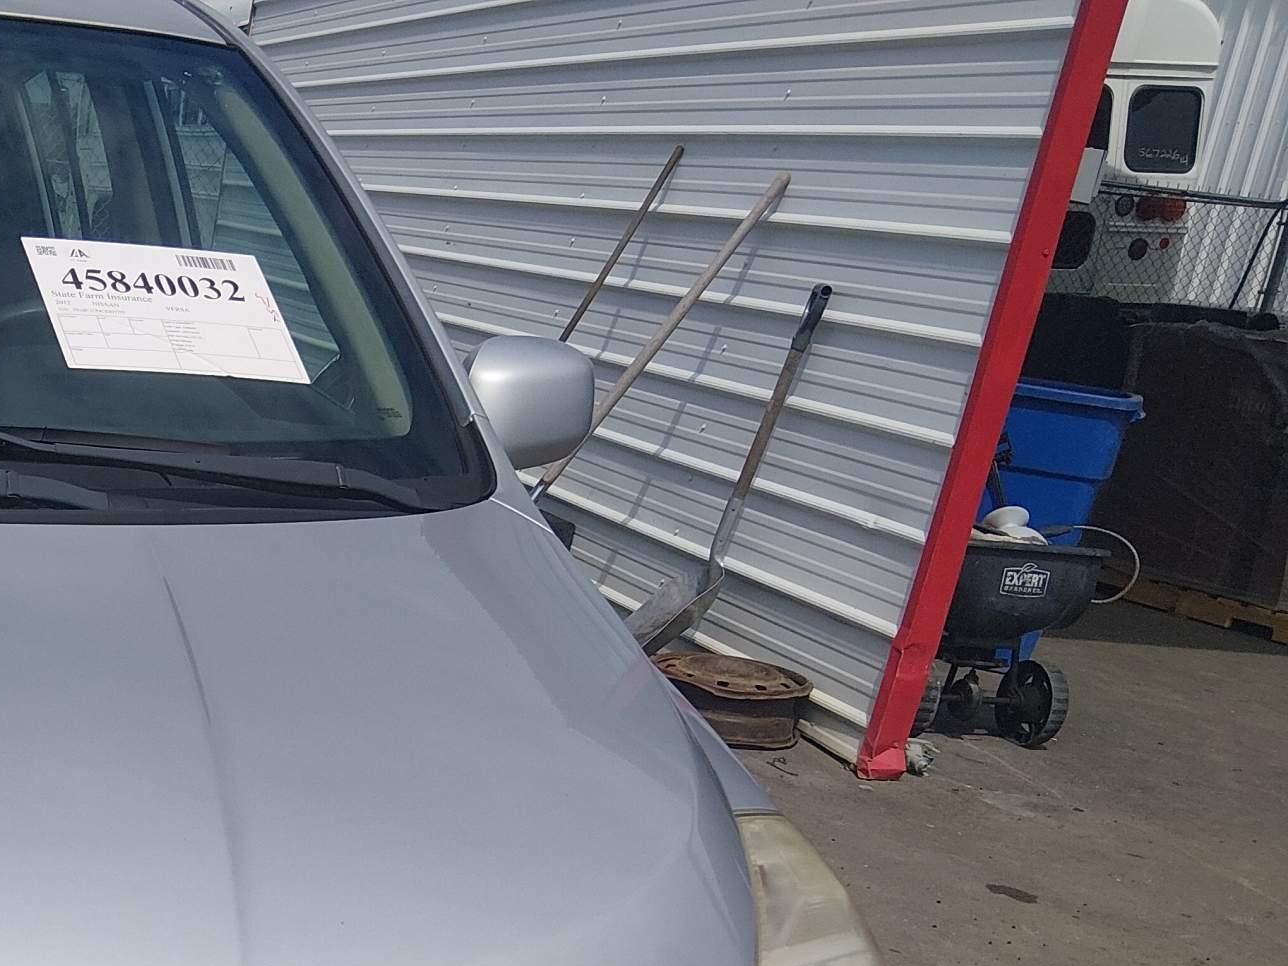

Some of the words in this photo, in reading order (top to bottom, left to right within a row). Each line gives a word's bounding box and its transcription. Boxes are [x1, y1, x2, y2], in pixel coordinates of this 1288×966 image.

[62, 268, 245, 302] 45840032
[51, 290, 76, 298] State
[79, 292, 104, 300] Farm
[107, 293, 153, 303] Insurance
[1005, 571, 1046, 587] EXPERT
